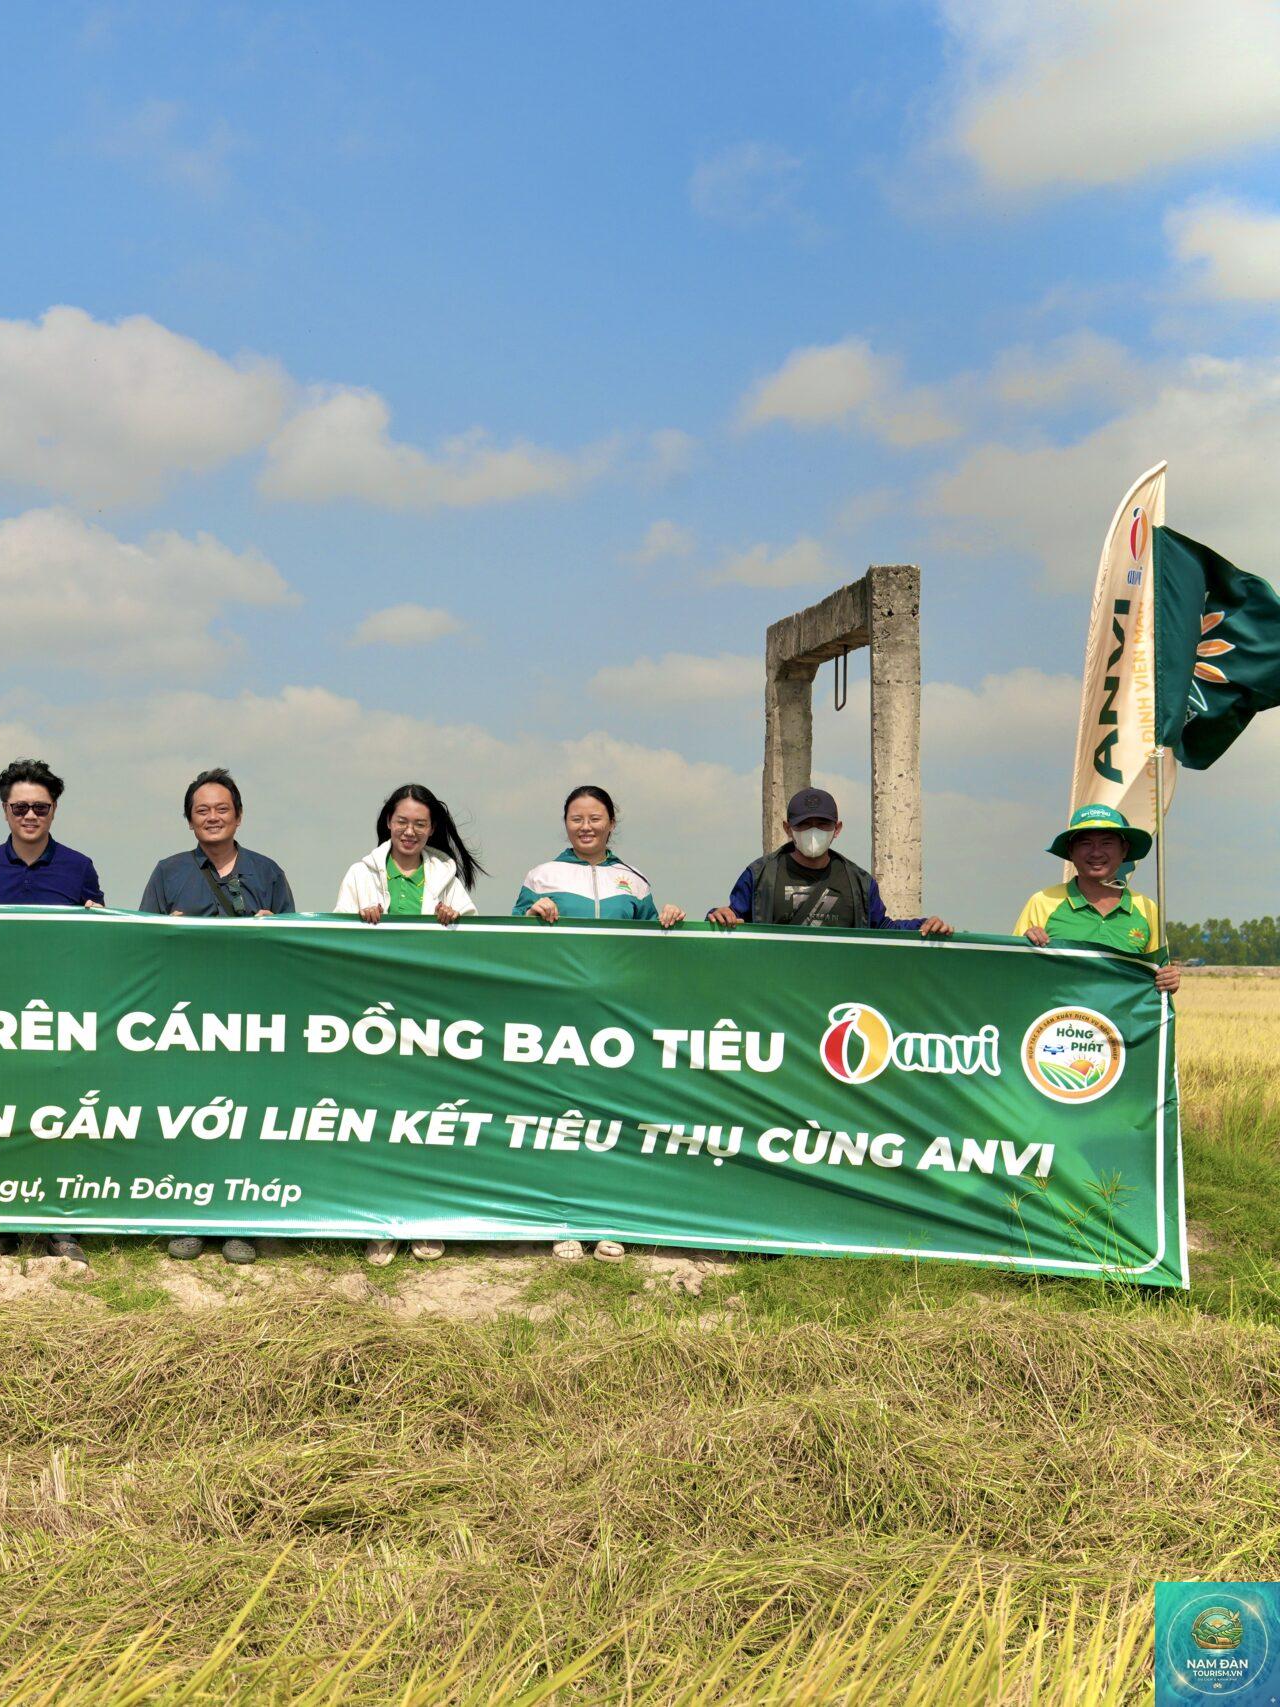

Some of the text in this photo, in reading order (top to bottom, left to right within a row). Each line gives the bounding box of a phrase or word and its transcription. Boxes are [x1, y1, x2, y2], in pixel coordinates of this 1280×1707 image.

[1094, 599, 1131, 784] ANVI
[116, 1002, 286, 1053] CÁNH
[303, 1001, 484, 1060] ĐỒNG
[503, 1022, 635, 1069] BAO
[652, 1018, 785, 1073] TIÊU
[892, 1024, 1001, 1076] anvi
[1071, 1040, 1104, 1053] PHÁT
[30, 1090, 142, 1140] GẮN
[156, 1096, 247, 1140] VỚI
[260, 1098, 377, 1143] LIÊN
[388, 1099, 493, 1147] KẾT
[504, 1110, 622, 1152] TIÊU
[637, 1123, 744, 1167] THỤ
[757, 1120, 907, 1168] CÙNG
[917, 1137, 1055, 1178] ANVI
[56, 1174, 121, 1200] Tỉnh
[130, 1174, 214, 1206] Đồng
[224, 1178, 302, 1208] Tháp
